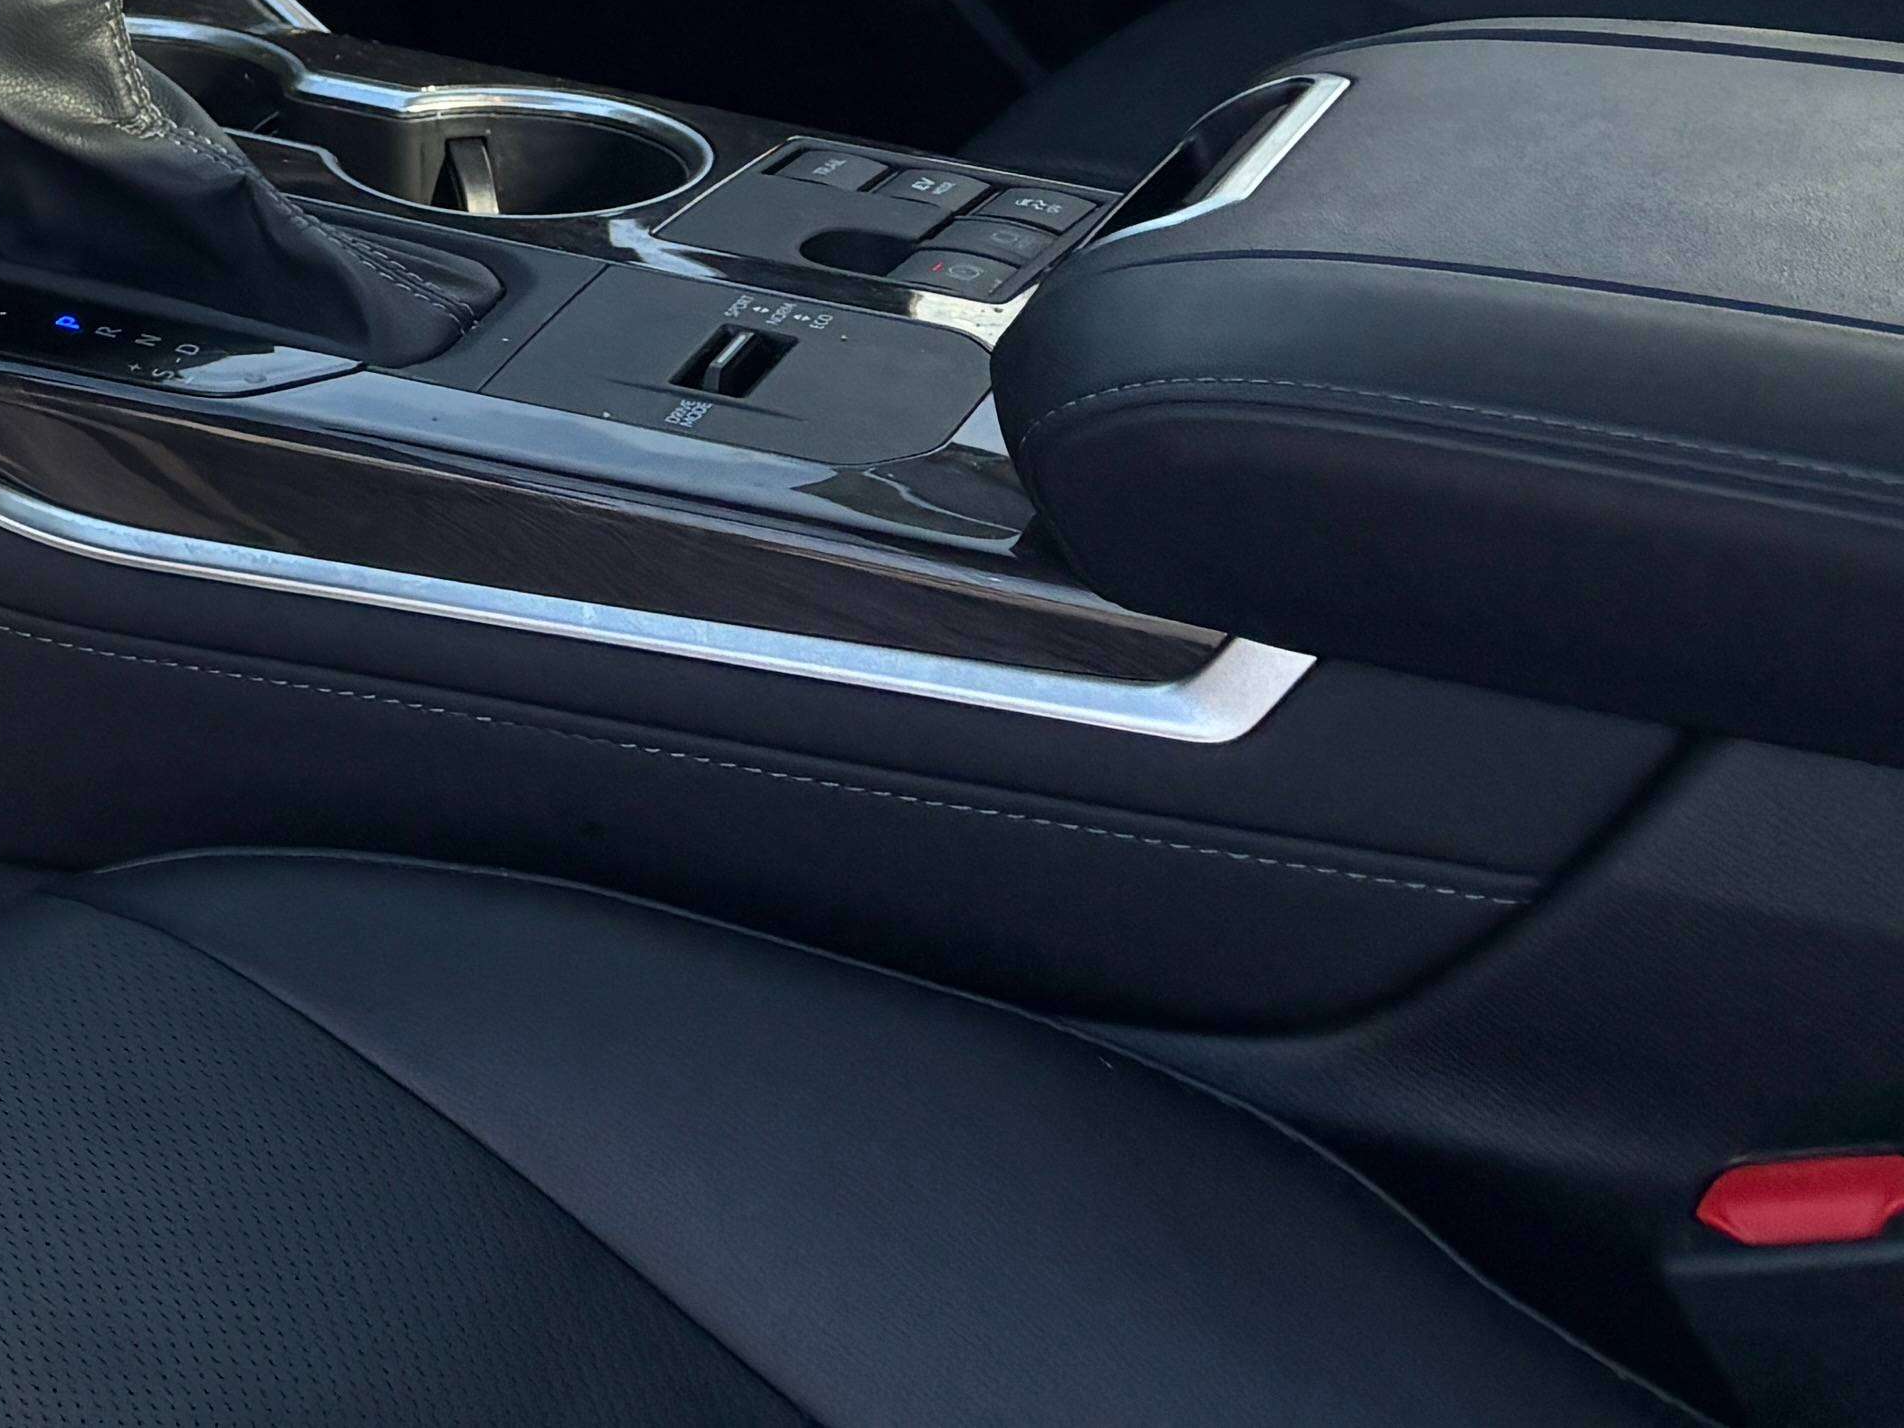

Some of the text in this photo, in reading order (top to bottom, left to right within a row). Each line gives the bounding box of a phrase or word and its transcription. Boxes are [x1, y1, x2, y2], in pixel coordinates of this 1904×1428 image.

[911, 176, 935, 192] EV
[723, 294, 755, 318] SPORT
[55, 315, 80, 330] P
[809, 313, 834, 330] ECO
[95, 326, 122, 339] R
[134, 333, 162, 347] N
[175, 344, 200, 356] D
[151, 368, 175, 380] S
[664, 399, 696, 425] DRIVE
[679, 401, 714, 428] MODE
